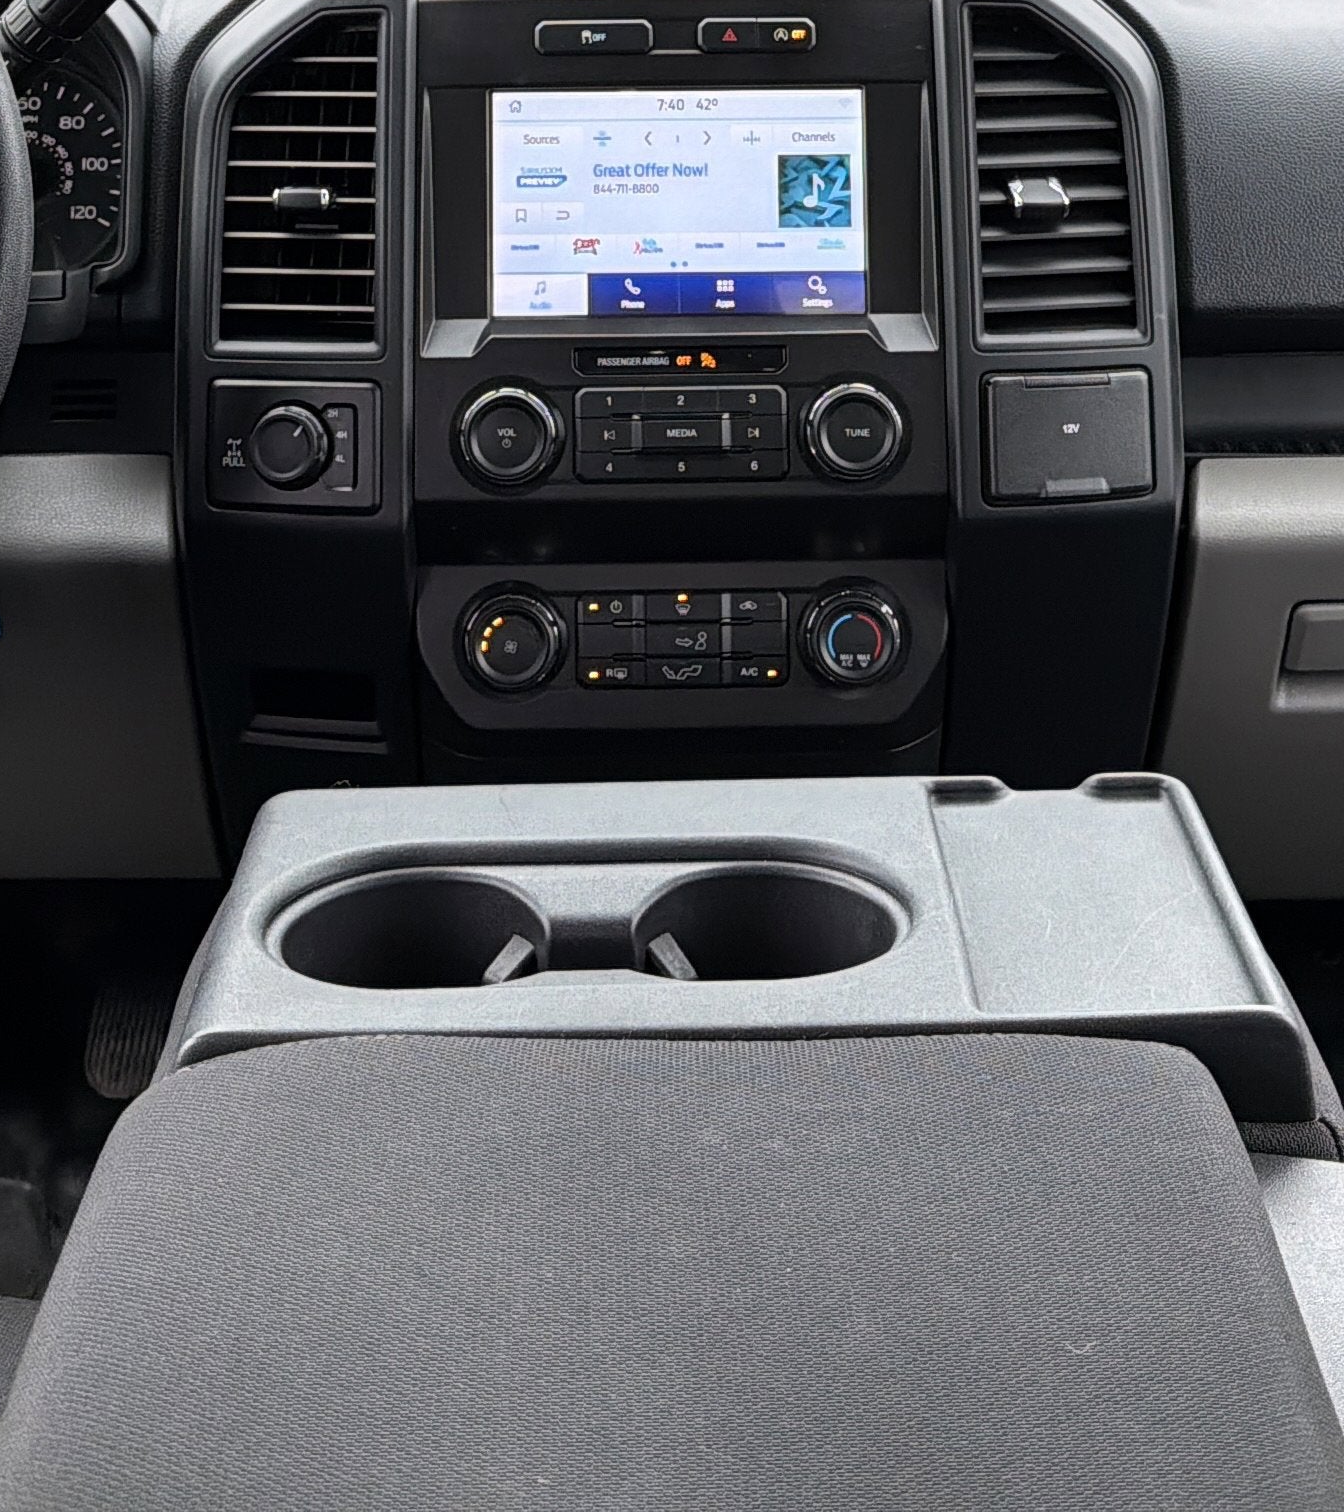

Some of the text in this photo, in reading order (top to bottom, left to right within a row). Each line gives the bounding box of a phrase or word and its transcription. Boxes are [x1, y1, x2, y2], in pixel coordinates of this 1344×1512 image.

[592, 33, 607, 42] OFF
[657, 98, 685, 111] 7:40
[59, 116, 85, 130] 80
[523, 133, 560, 146] Sources
[791, 131, 836, 143] Channels
[81, 157, 109, 172] 100
[593, 163, 709, 178] Great Offer Now!
[520, 177, 563, 186] PREVIEW
[70, 205, 97, 220] 120
[620, 299, 645, 310] Phone
[715, 299, 735, 310] Apps
[801, 297, 834, 309] Settings
[596, 355, 692, 368] PASSENGER AIRBAG OFF
[605, 394, 612, 406] 1
[676, 394, 684, 406] 2
[748, 393, 756, 405] 3
[497, 427, 517, 438] VOL
[666, 427, 698, 439] MEDIA
[844, 427, 871, 438] TUNE
[1062, 422, 1081, 434] 12V
[222, 456, 246, 468] PULL
[605, 462, 613, 473] 4
[678, 461, 686, 473] 5
[750, 460, 759, 472] 6
[740, 666, 759, 678] A/C
